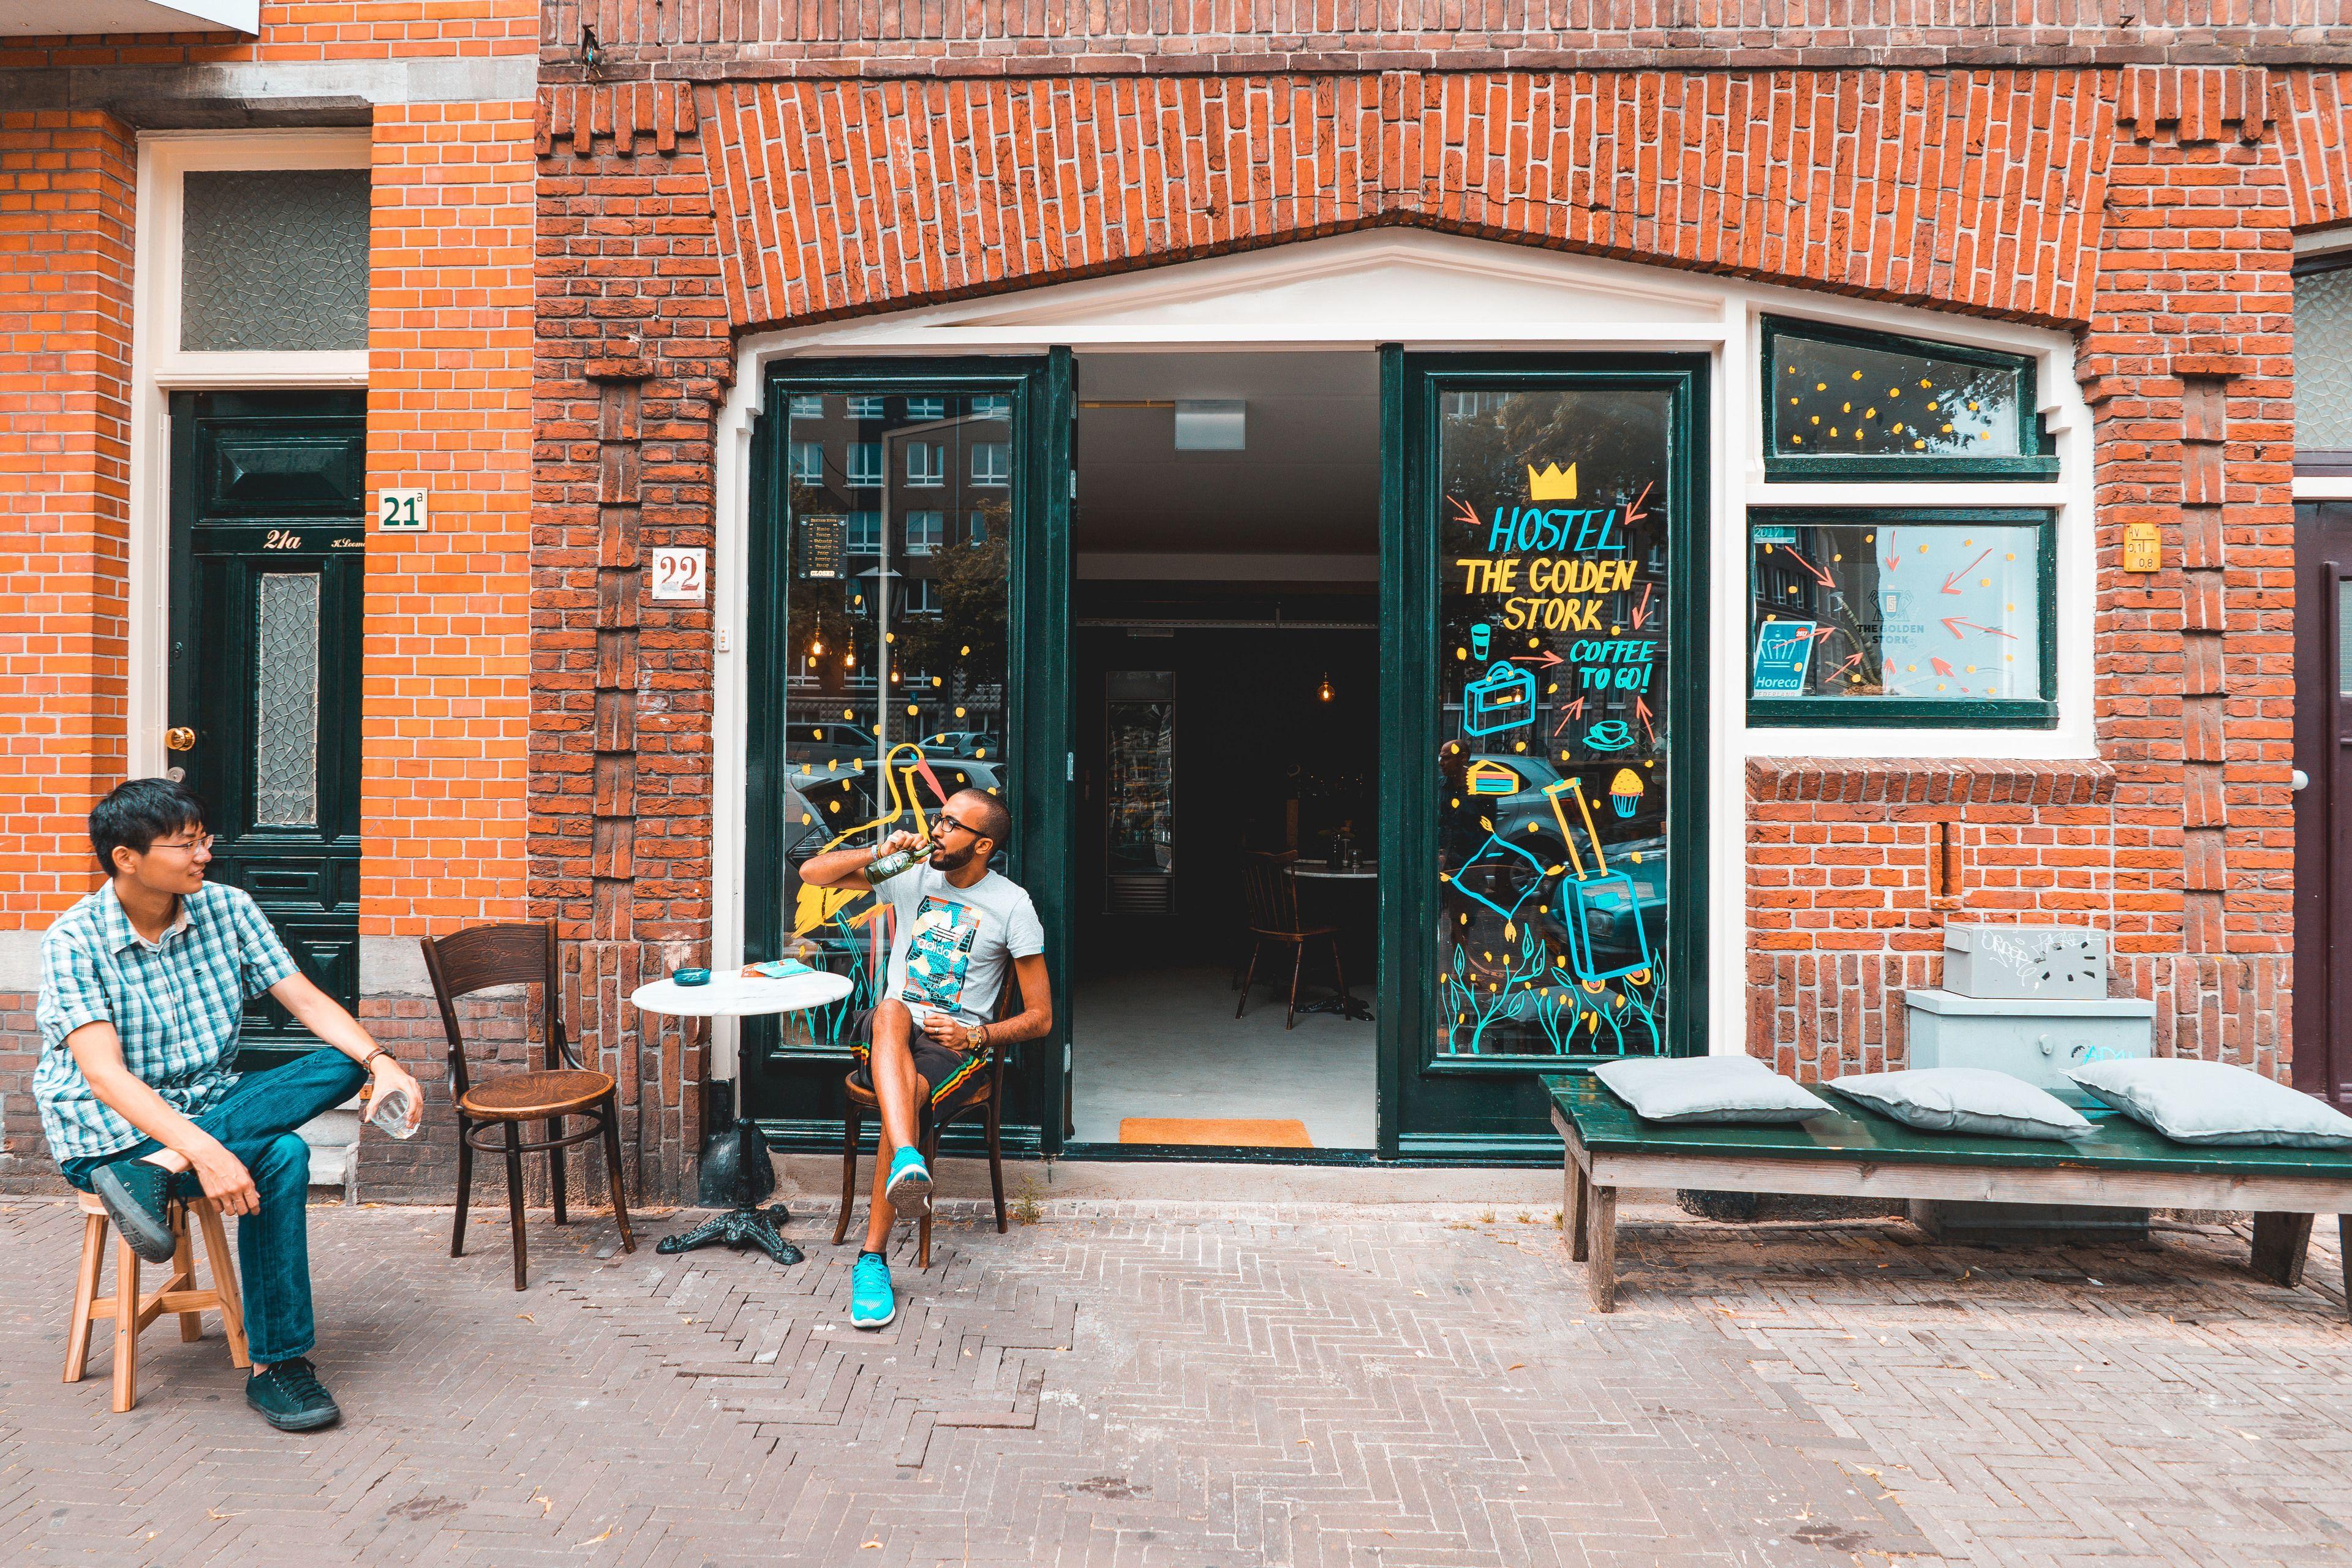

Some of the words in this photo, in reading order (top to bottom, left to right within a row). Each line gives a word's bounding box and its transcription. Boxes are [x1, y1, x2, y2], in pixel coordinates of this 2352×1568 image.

[263, 530, 301, 549] 21a
[1488, 507, 1626, 552] HOSTEL
[1755, 527, 1781, 537] 2017
[2128, 529, 2139, 537] HV
[660, 556, 700, 591] 22
[2139, 559, 2153, 568] 0,8
[1456, 559, 1521, 594] THE
[1529, 557, 1638, 594] GOLDEN
[1502, 597, 1603, 631] STORK
[1856, 625, 1878, 633] THE
[1880, 625, 1924, 633] GOLDEN
[1570, 639, 1659, 663] COFFEE
[1579, 667, 1611, 690] TO
[1615, 663, 1653, 693] GO!
[1755, 676, 1798, 688] Horeca
